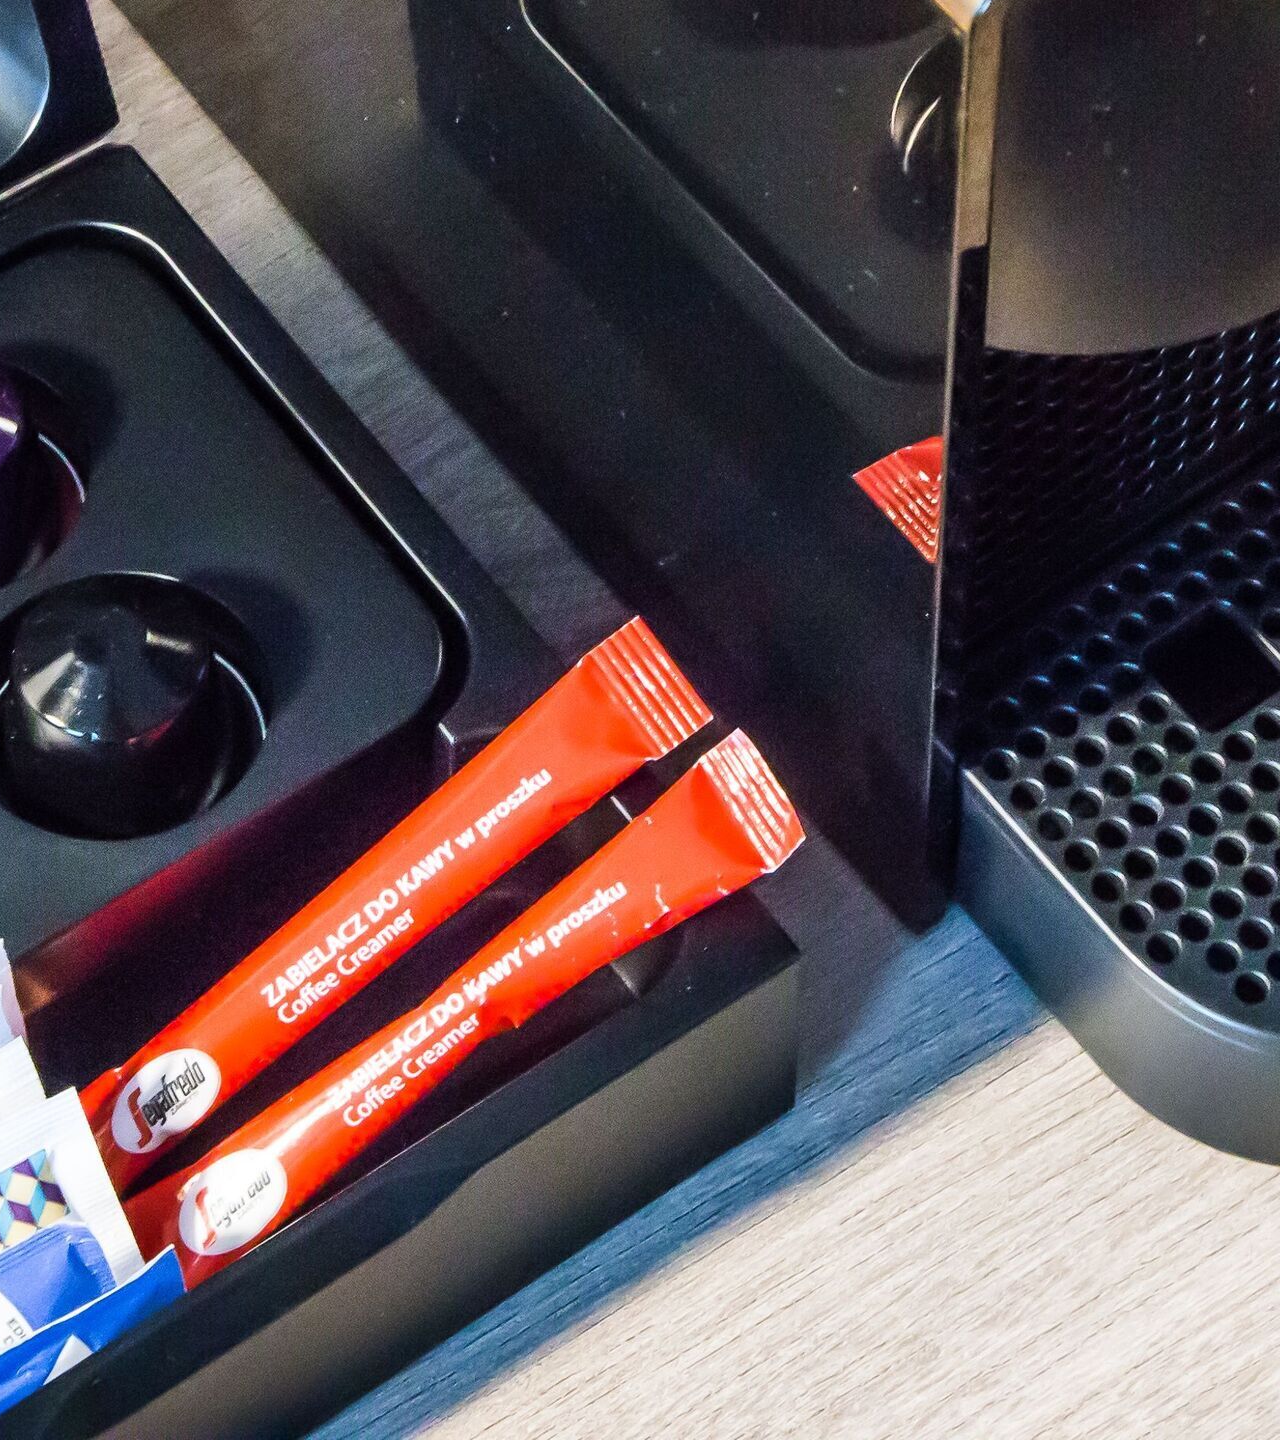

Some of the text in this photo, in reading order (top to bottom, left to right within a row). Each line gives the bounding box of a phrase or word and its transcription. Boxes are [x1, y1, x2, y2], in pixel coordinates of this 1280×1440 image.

[260, 768, 552, 1008] ZABIELACZ DO KAWY w proszku
[277, 908, 414, 1026] Coffee Creamer
[326, 879, 628, 1113] ZABIELACZ DO KAWY w proszku
[127, 1058, 205, 1149] Segafredo
[343, 1011, 480, 1128] Coffee Creamer
